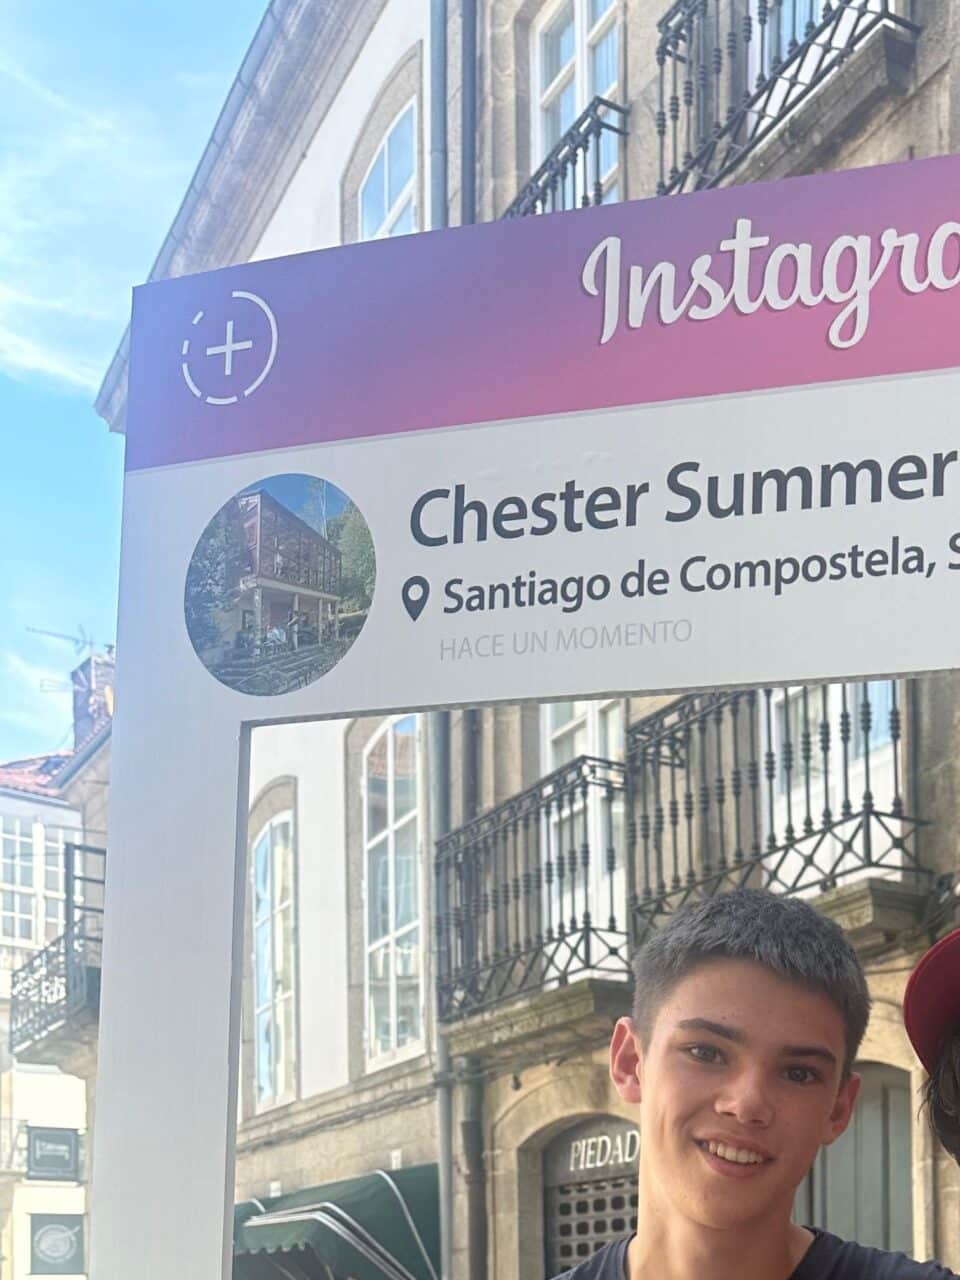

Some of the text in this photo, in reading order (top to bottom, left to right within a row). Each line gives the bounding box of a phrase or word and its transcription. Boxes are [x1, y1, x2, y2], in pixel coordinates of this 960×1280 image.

[409, 479, 650, 548] Chester
[664, 449, 959, 523] Summer
[442, 570, 611, 615] Santiago
[620, 559, 670, 598] de
[679, 536, 937, 596] Compostela,
[439, 618, 694, 661] HACE UN MOMENTO
[568, 1128, 641, 1172] PIEDAD
